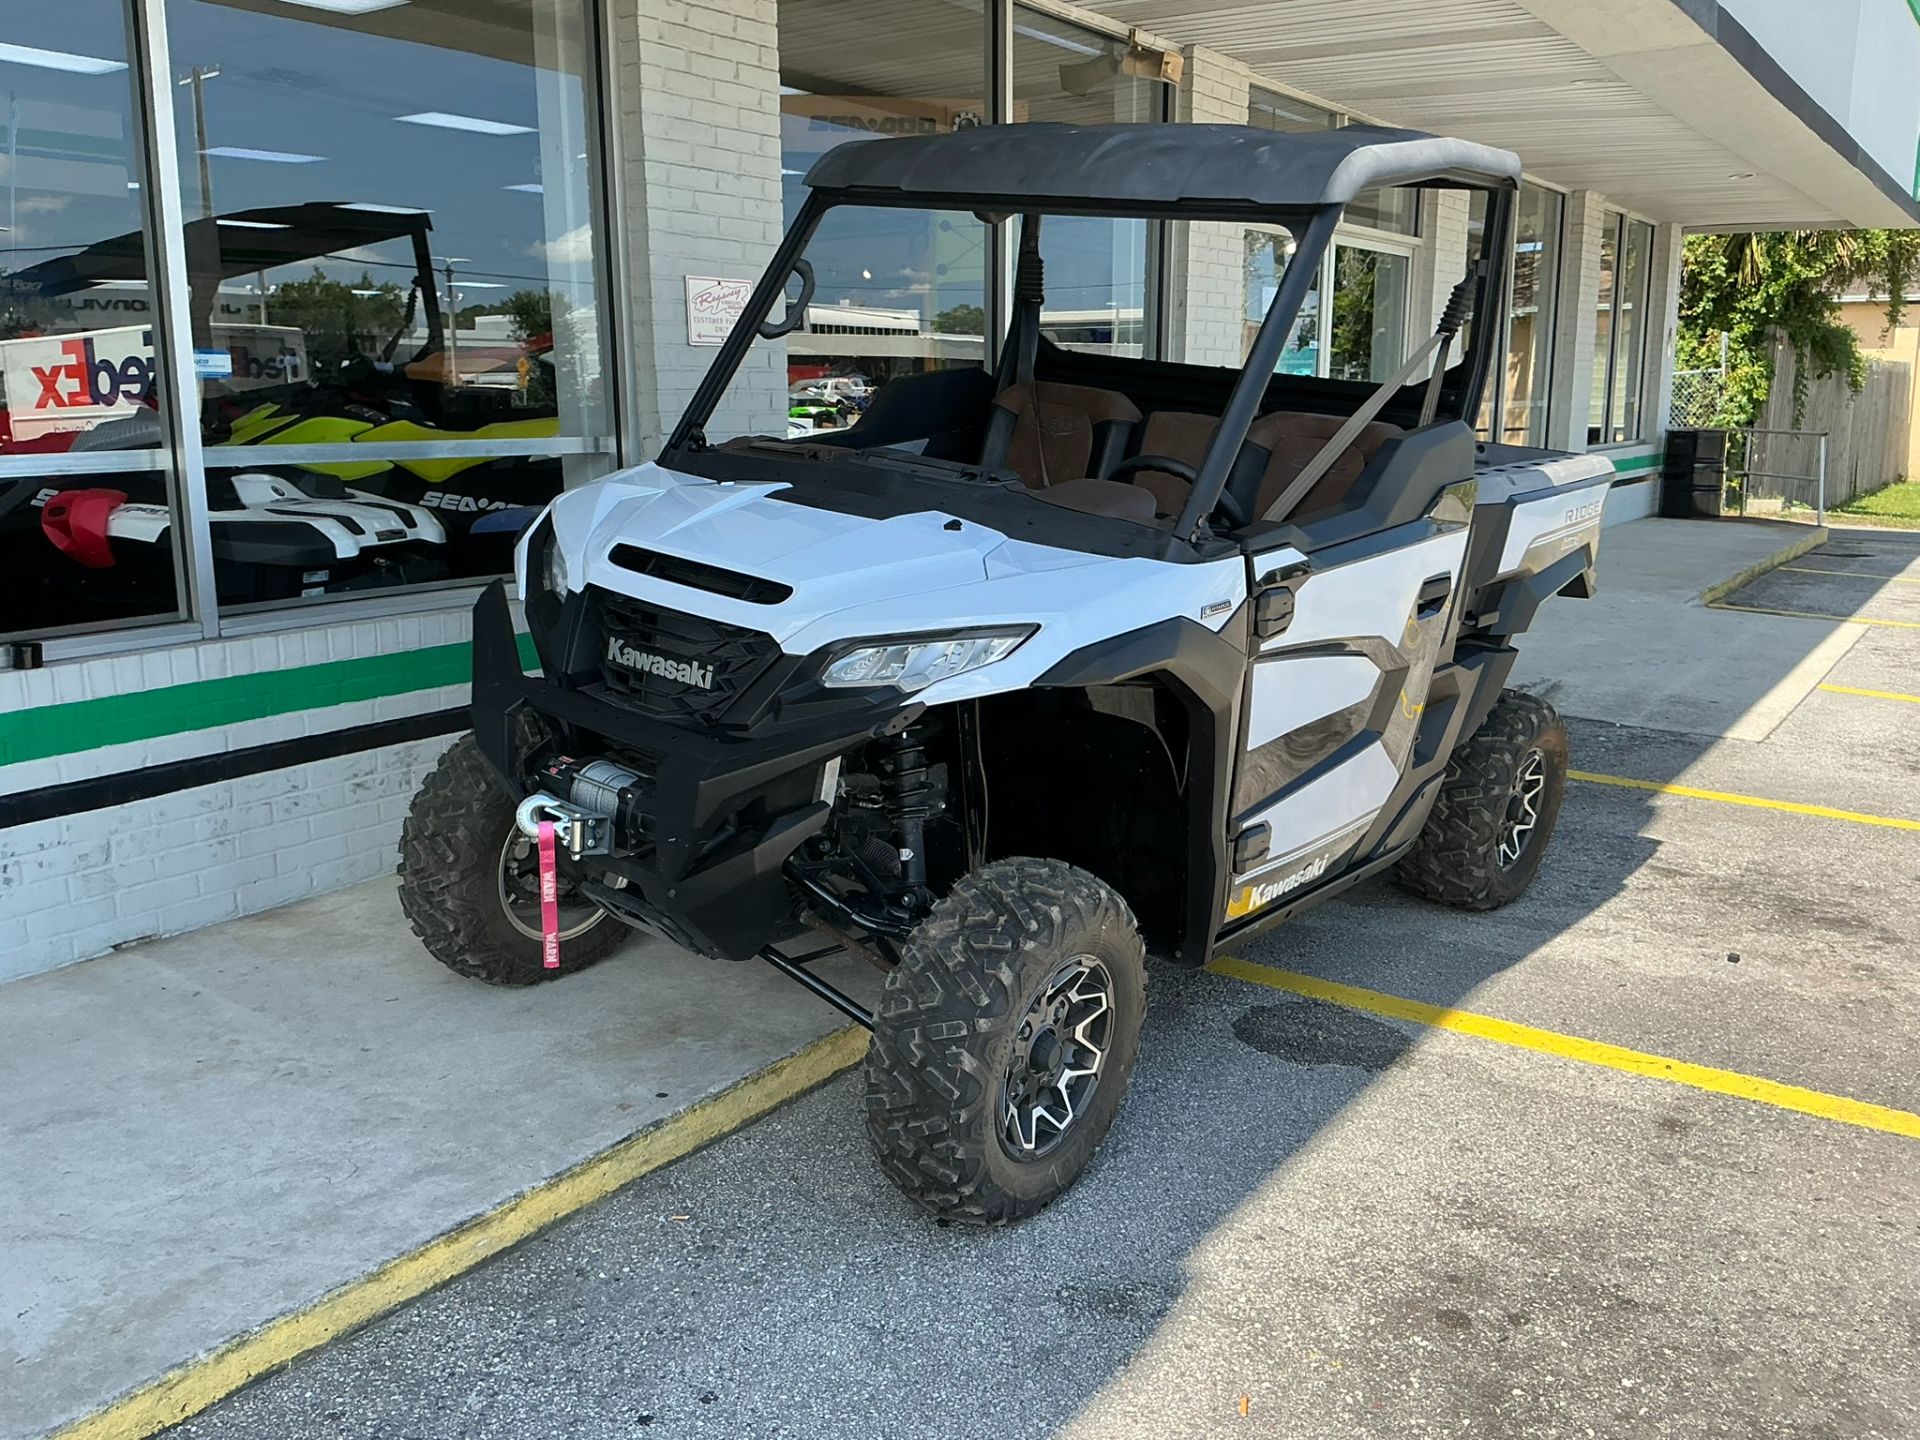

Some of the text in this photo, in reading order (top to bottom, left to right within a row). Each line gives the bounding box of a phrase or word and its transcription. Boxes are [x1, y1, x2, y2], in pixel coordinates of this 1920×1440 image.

[694, 288, 741, 312] Regency
[693, 317, 723, 325] CUSTOMER
[1565, 500, 1600, 523] RIDGE
[608, 636, 714, 690] Kawasaki
[542, 870, 555, 903] WARN
[1248, 853, 1329, 911] Kawasaki
[545, 932, 558, 963] WARN
